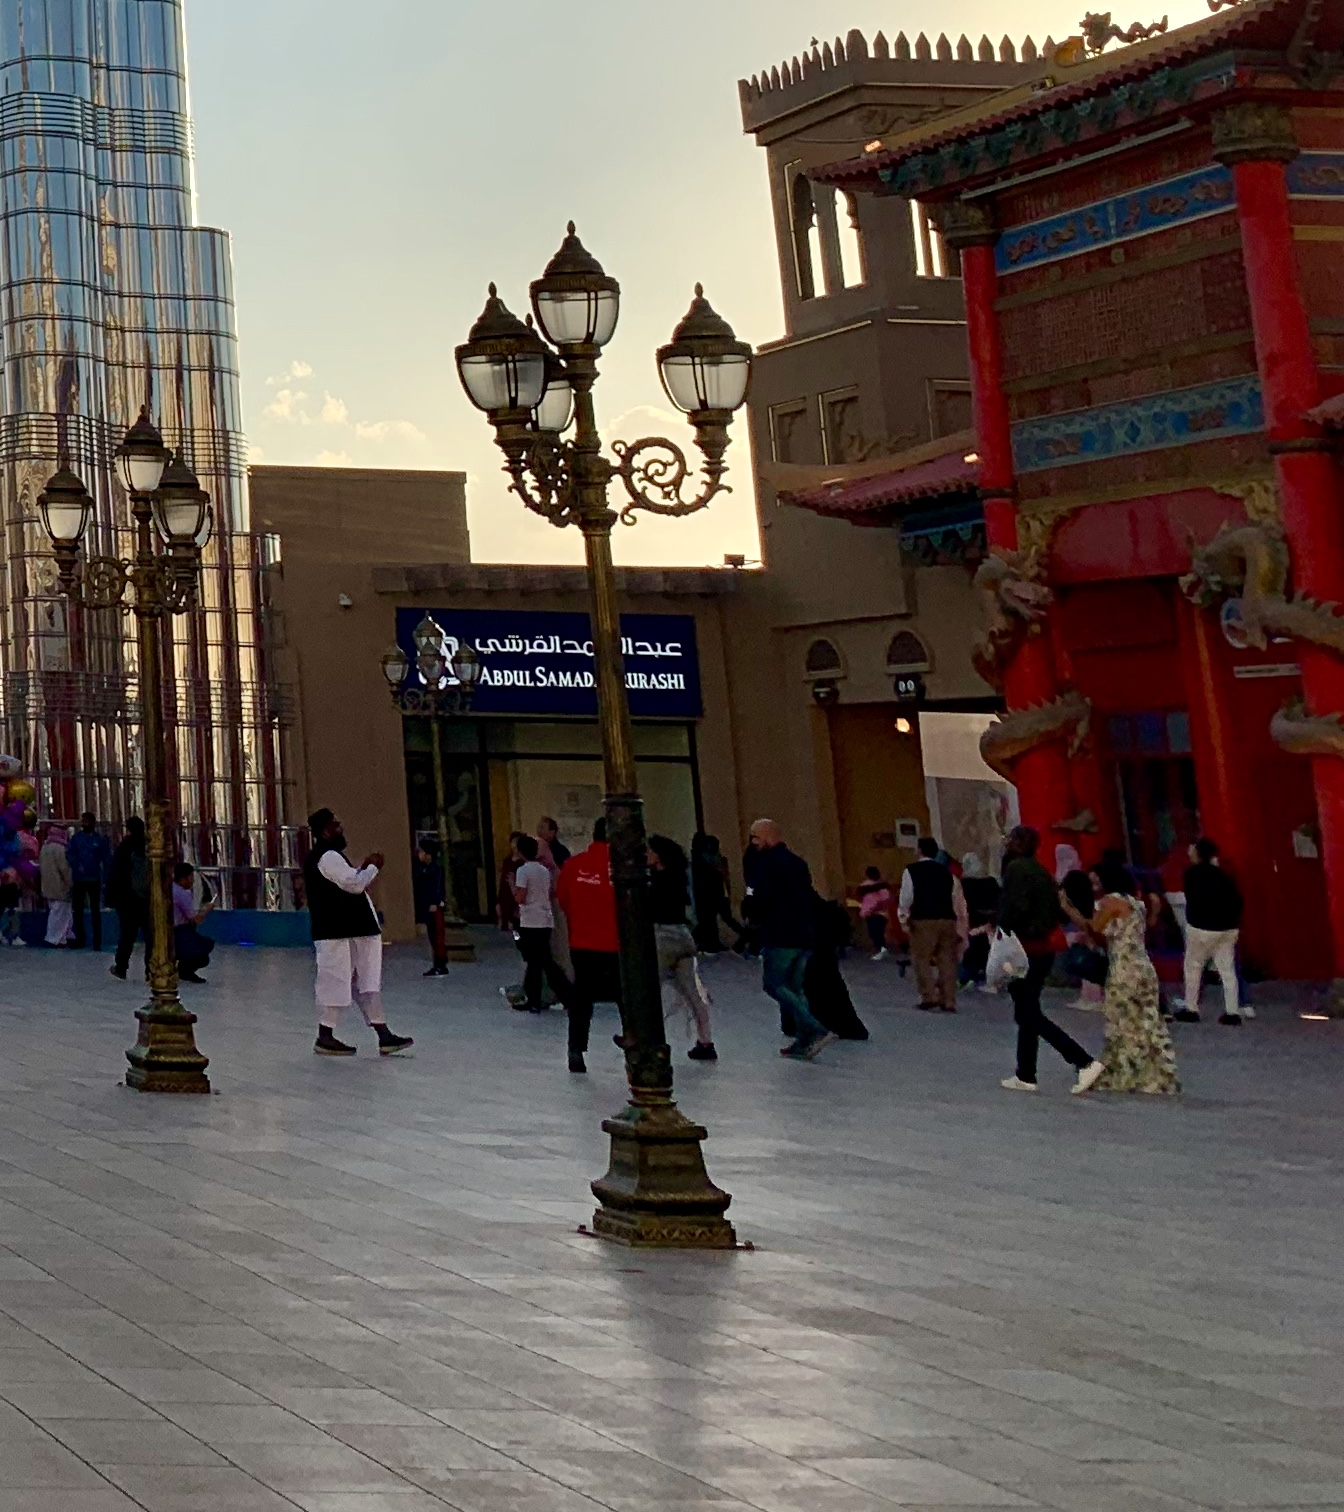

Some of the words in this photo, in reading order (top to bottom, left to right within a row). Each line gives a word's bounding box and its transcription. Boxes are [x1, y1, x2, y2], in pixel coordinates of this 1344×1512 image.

[479, 666, 535, 687] ABDUL
[535, 666, 594, 688] SAMAD
[624, 672, 686, 690] URASHI
